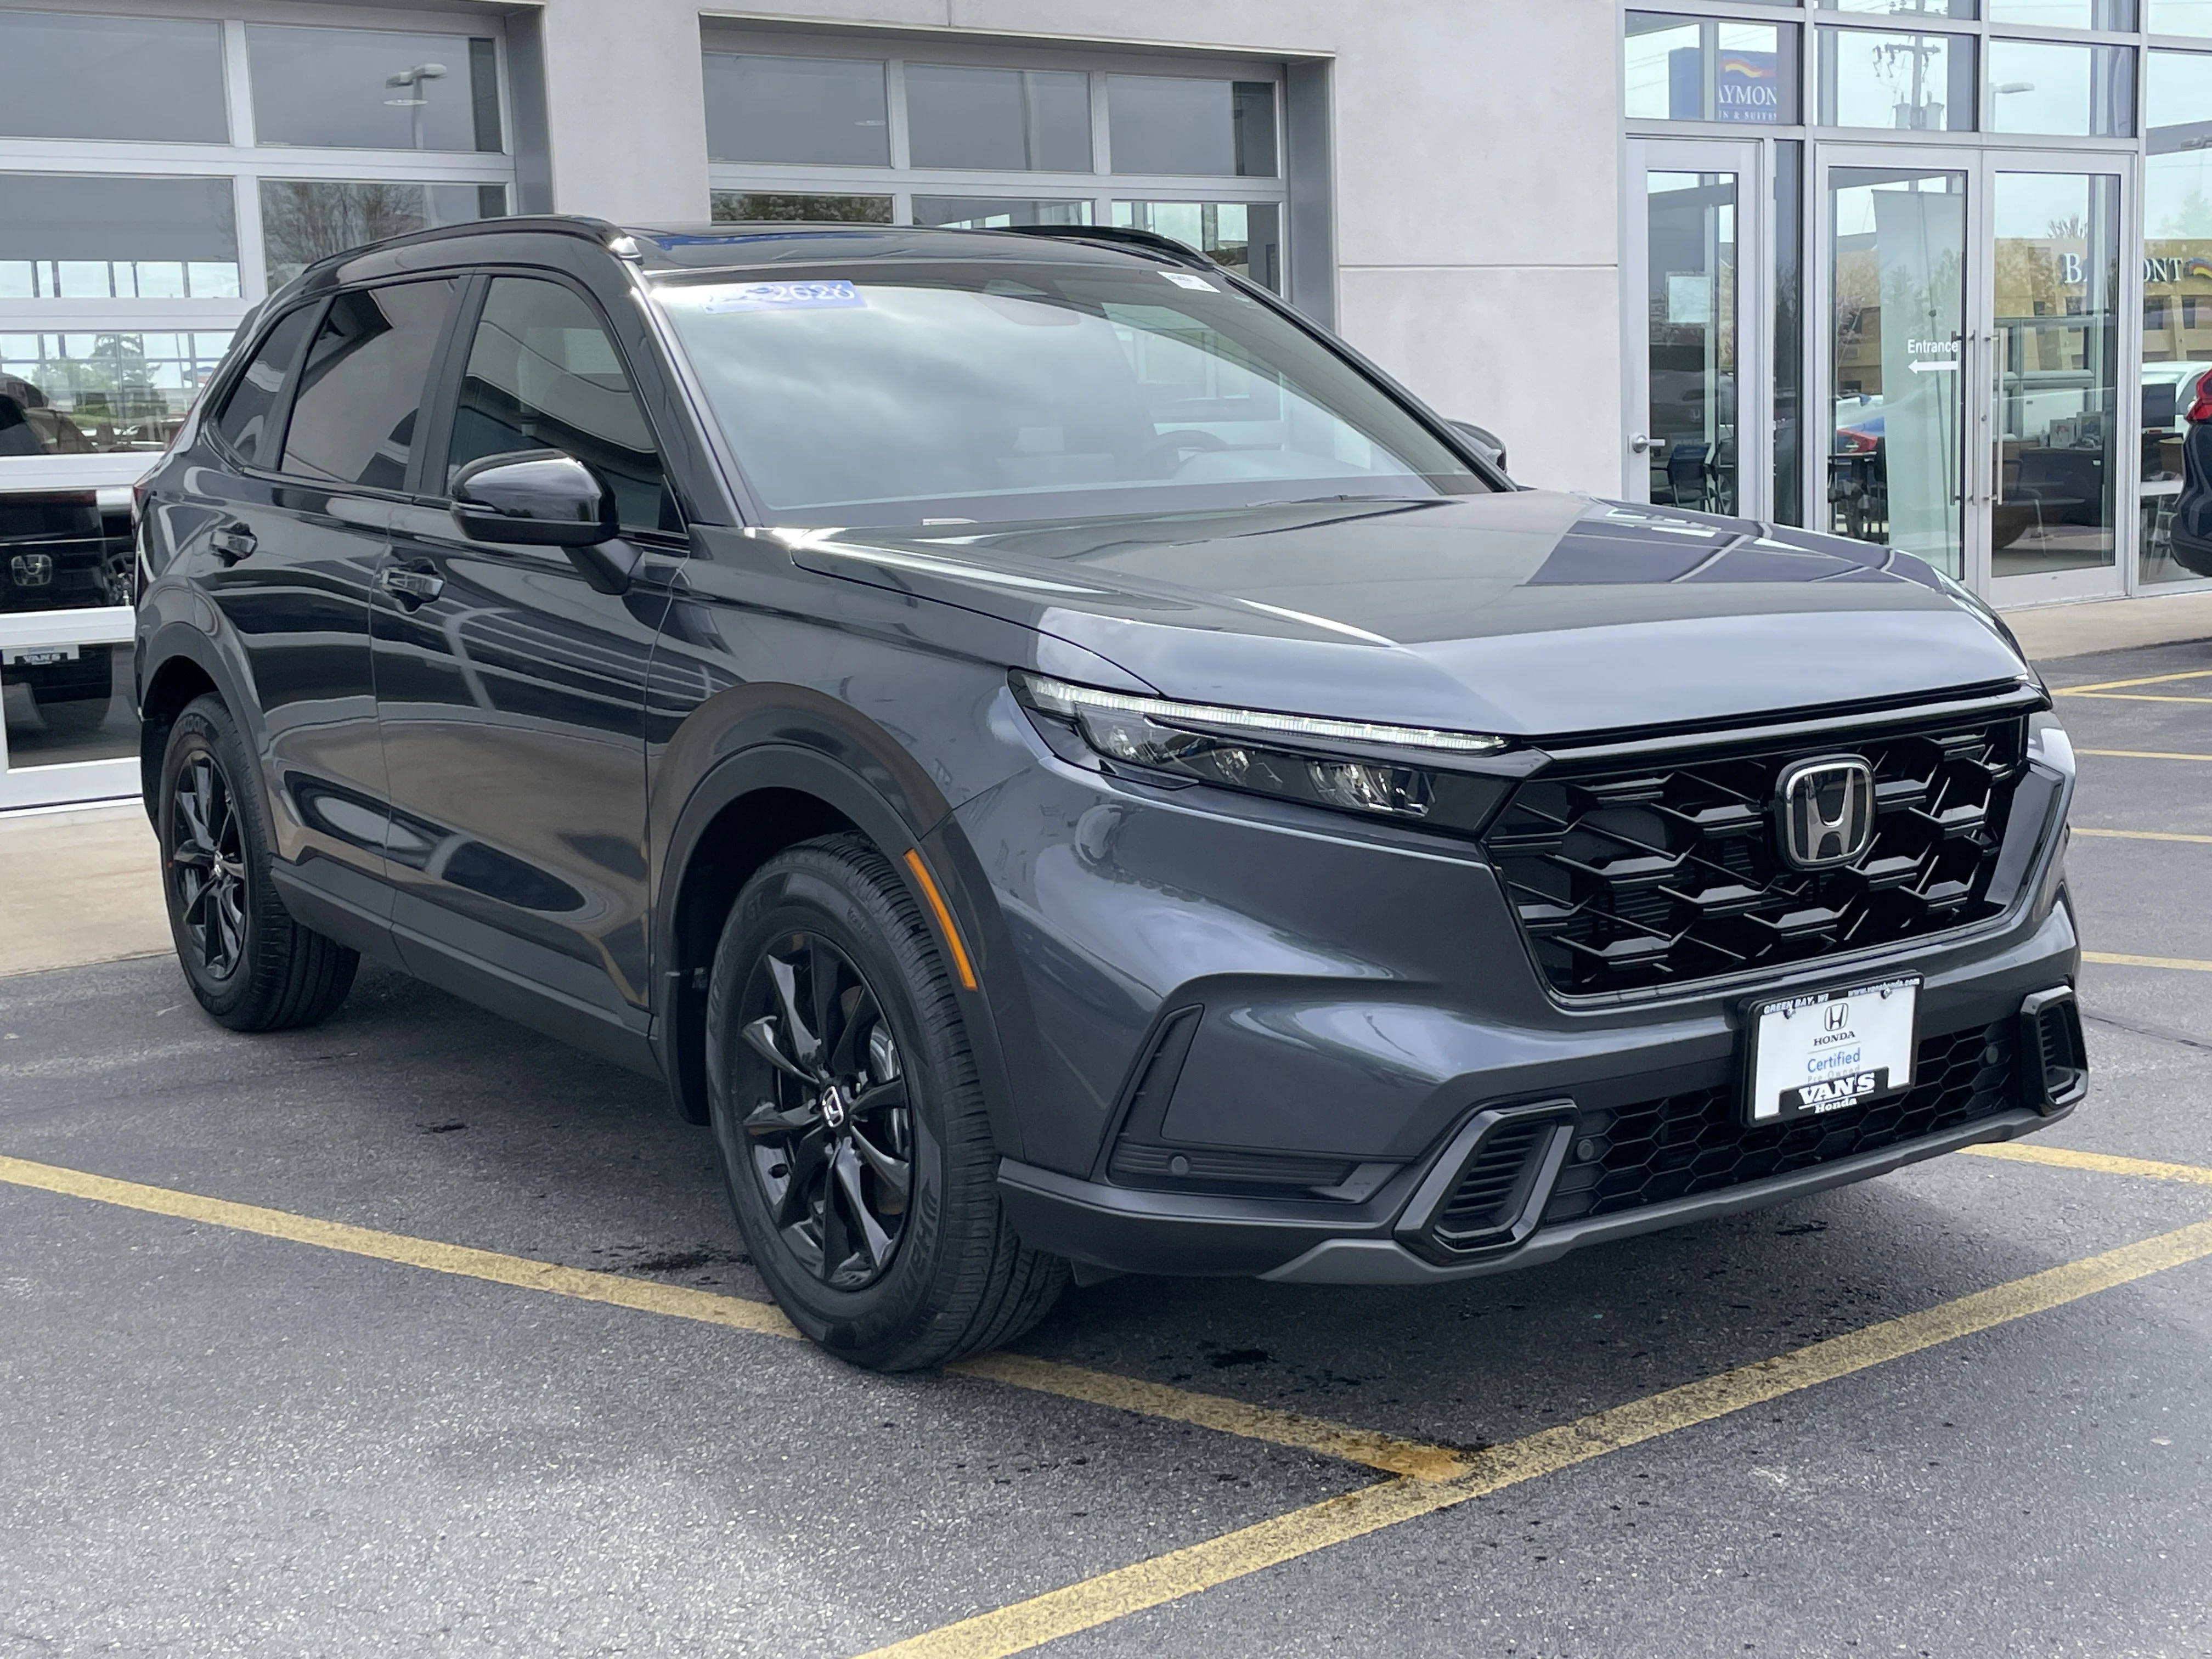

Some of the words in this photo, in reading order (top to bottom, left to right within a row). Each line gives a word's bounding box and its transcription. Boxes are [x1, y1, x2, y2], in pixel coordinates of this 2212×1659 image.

[1907, 338, 1959, 354] Entrance
[1763, 1000, 1794, 1014] GREEN
[1795, 996, 1815, 1008] BAY,
[1817, 993, 1829, 1003] WI
[1813, 1030, 1856, 1046] HONDA
[1807, 1047, 1861, 1073] Certified
[1807, 1065, 1860, 1084] Pre-Owned
[1814, 1097, 1858, 1114] Honda
